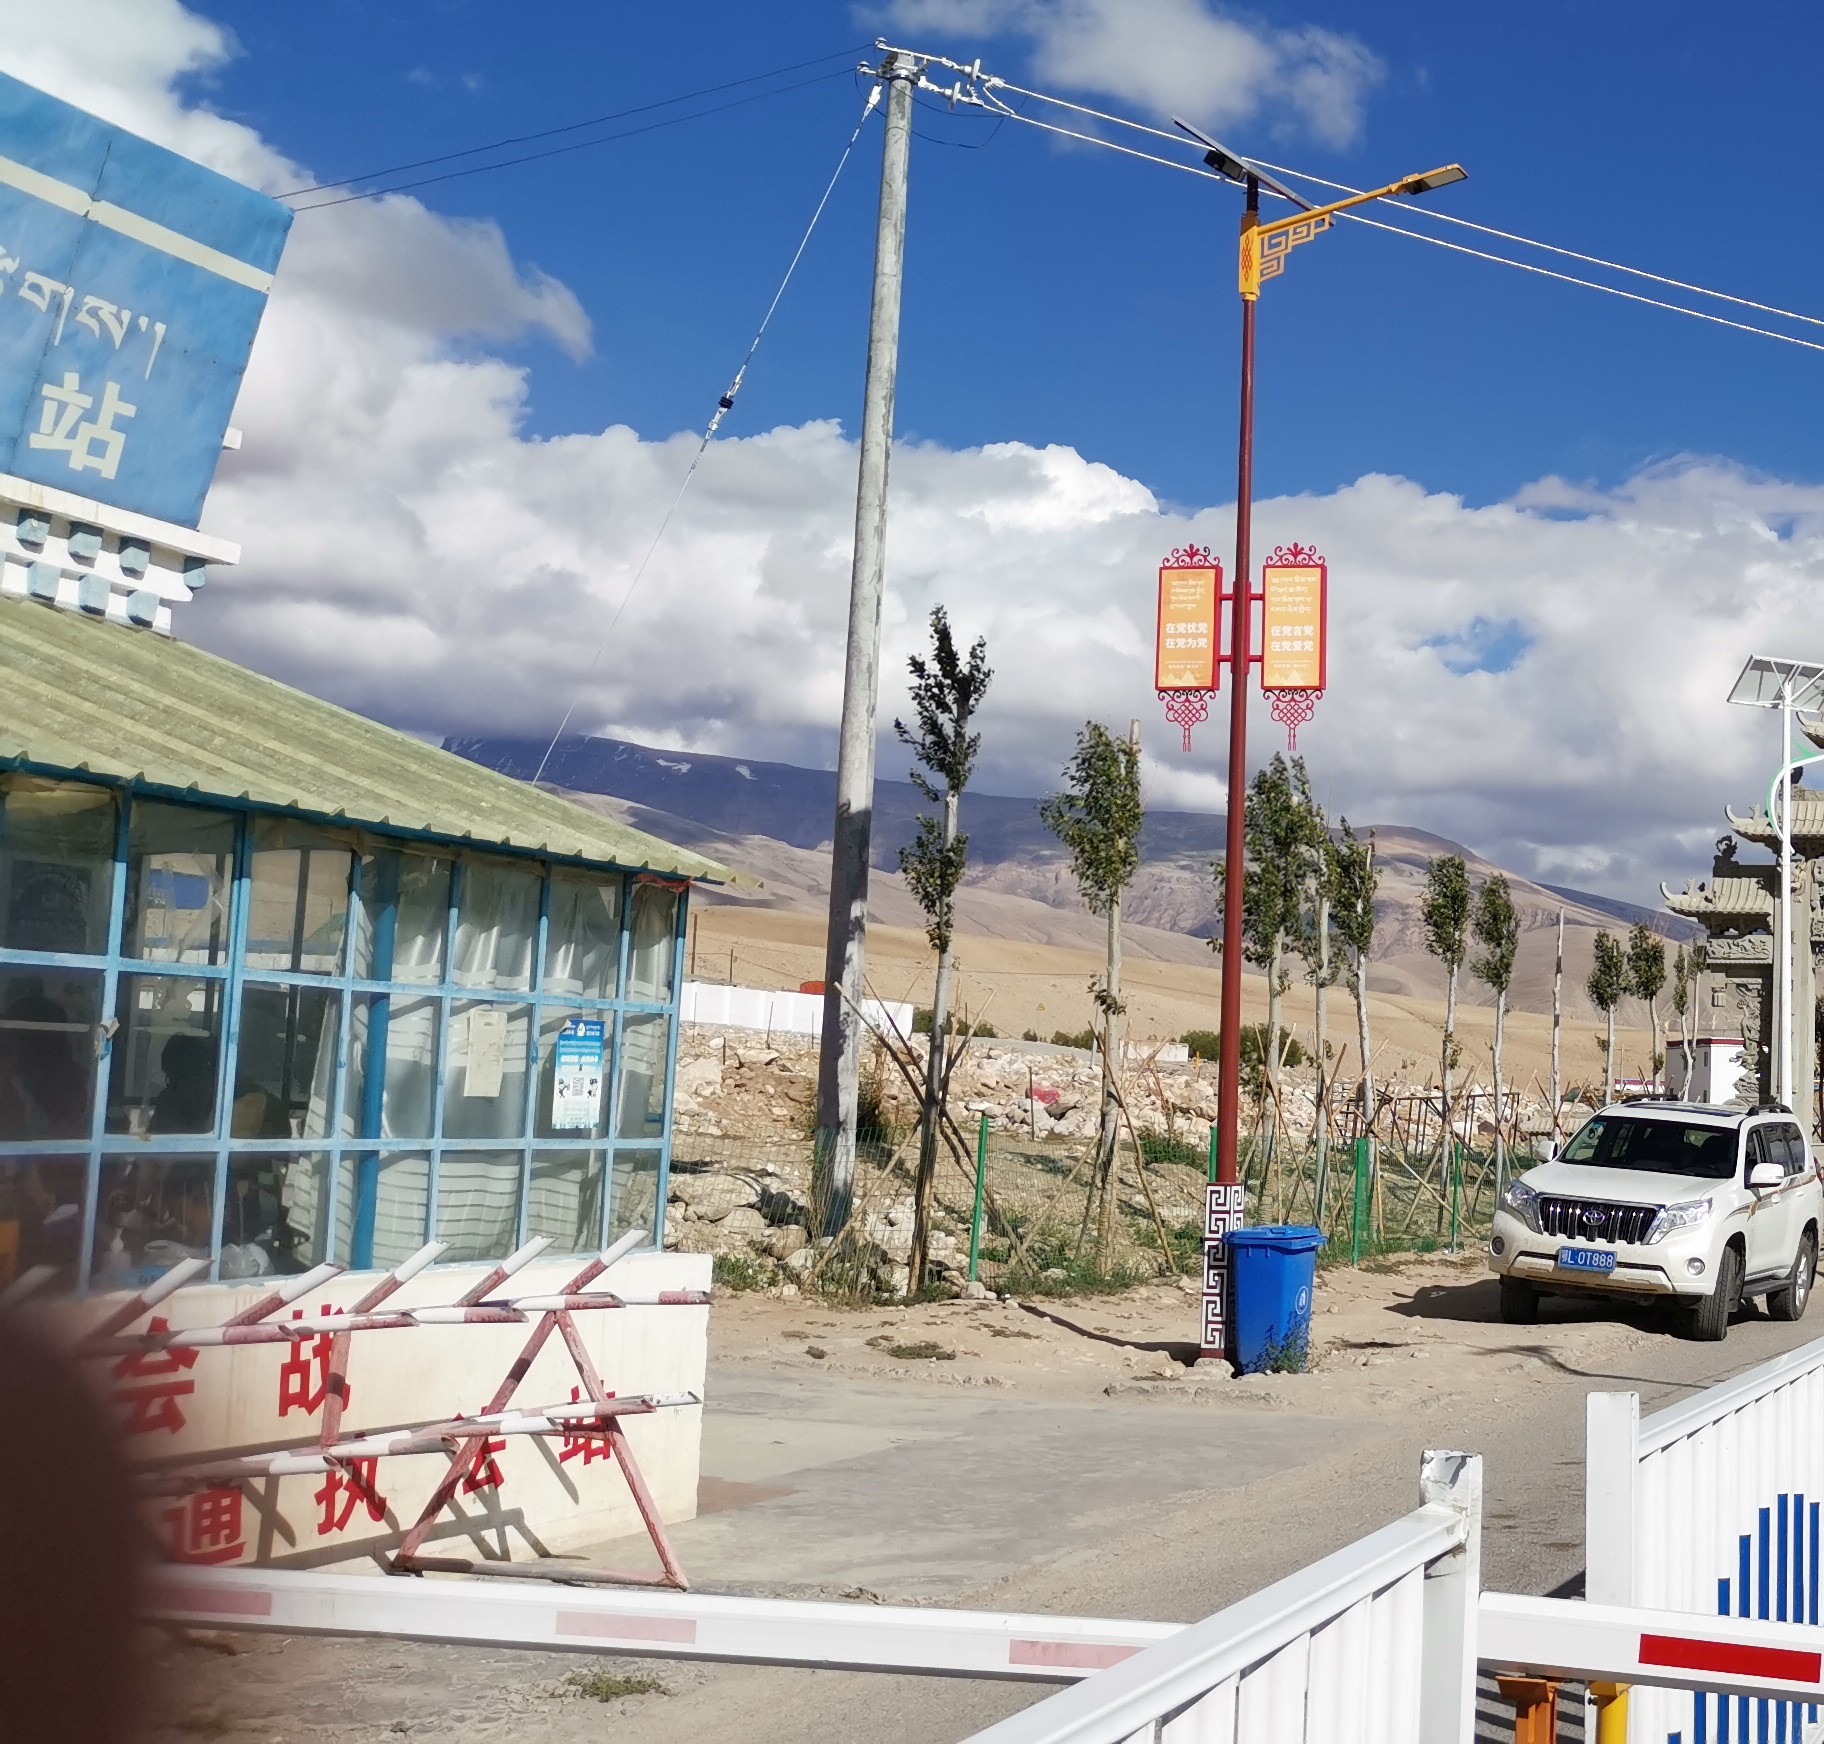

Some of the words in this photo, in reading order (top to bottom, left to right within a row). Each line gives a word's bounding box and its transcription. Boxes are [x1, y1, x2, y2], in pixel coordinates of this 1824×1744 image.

[29, 372, 137, 480] 站
[1165, 637, 1208, 649] 在党为党
